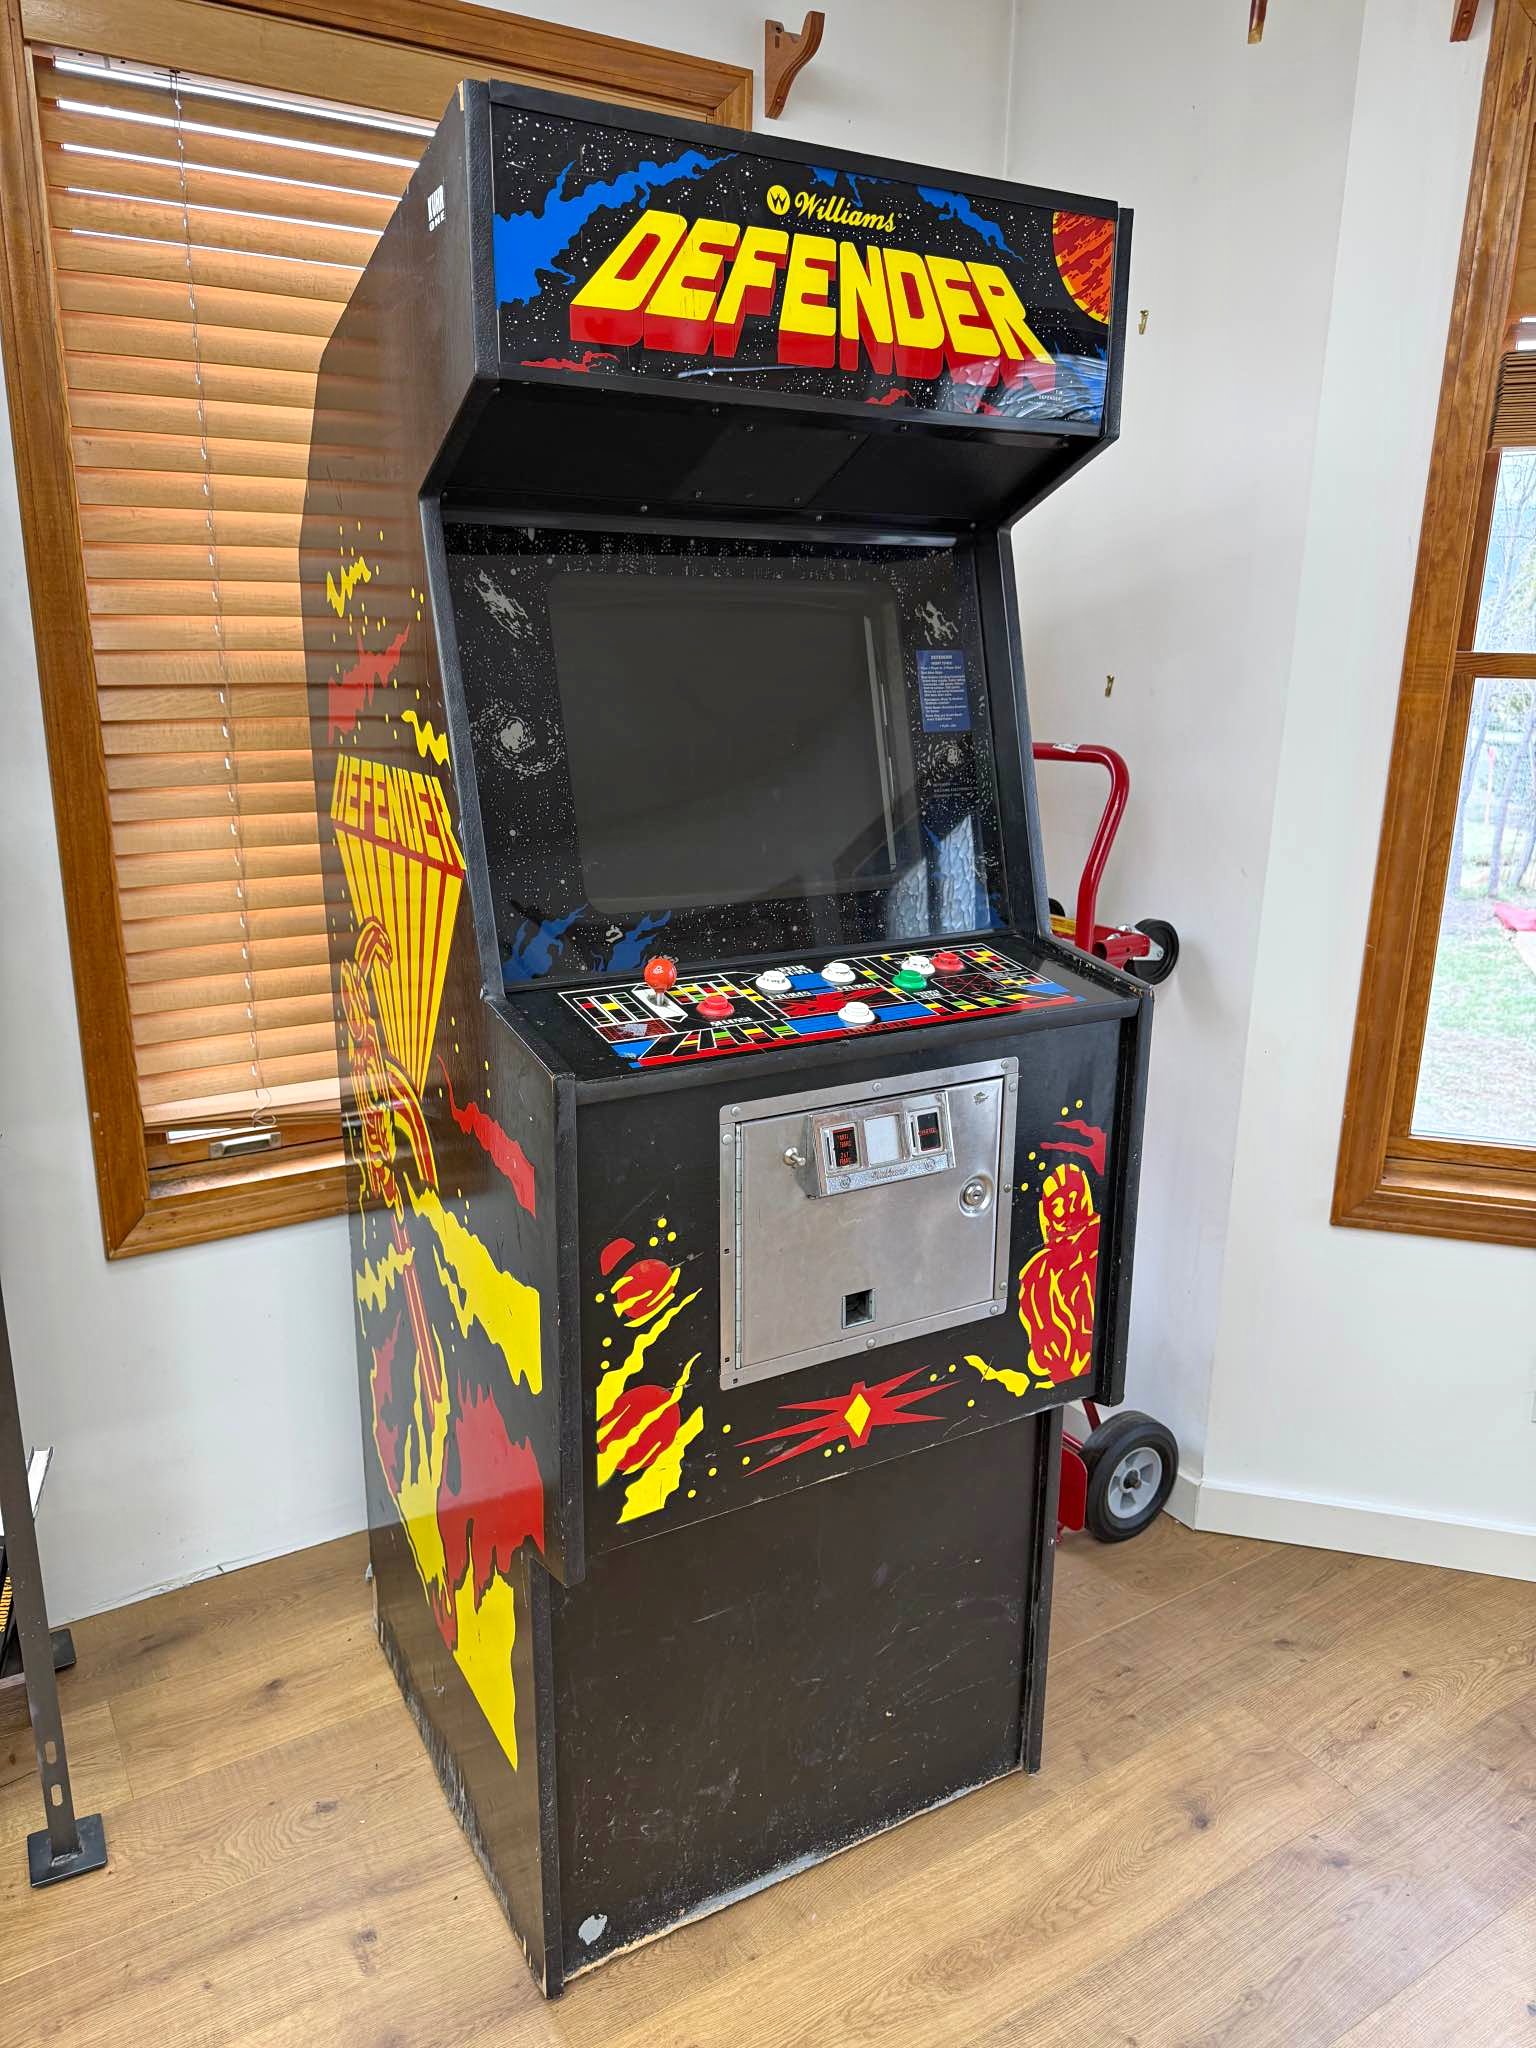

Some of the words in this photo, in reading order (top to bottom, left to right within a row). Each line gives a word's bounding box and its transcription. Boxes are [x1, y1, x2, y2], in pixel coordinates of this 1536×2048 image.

[795, 191, 896, 232] Williams
[570, 210, 1056, 370] DEFENDER
[330, 752, 468, 870] DEFENDER
